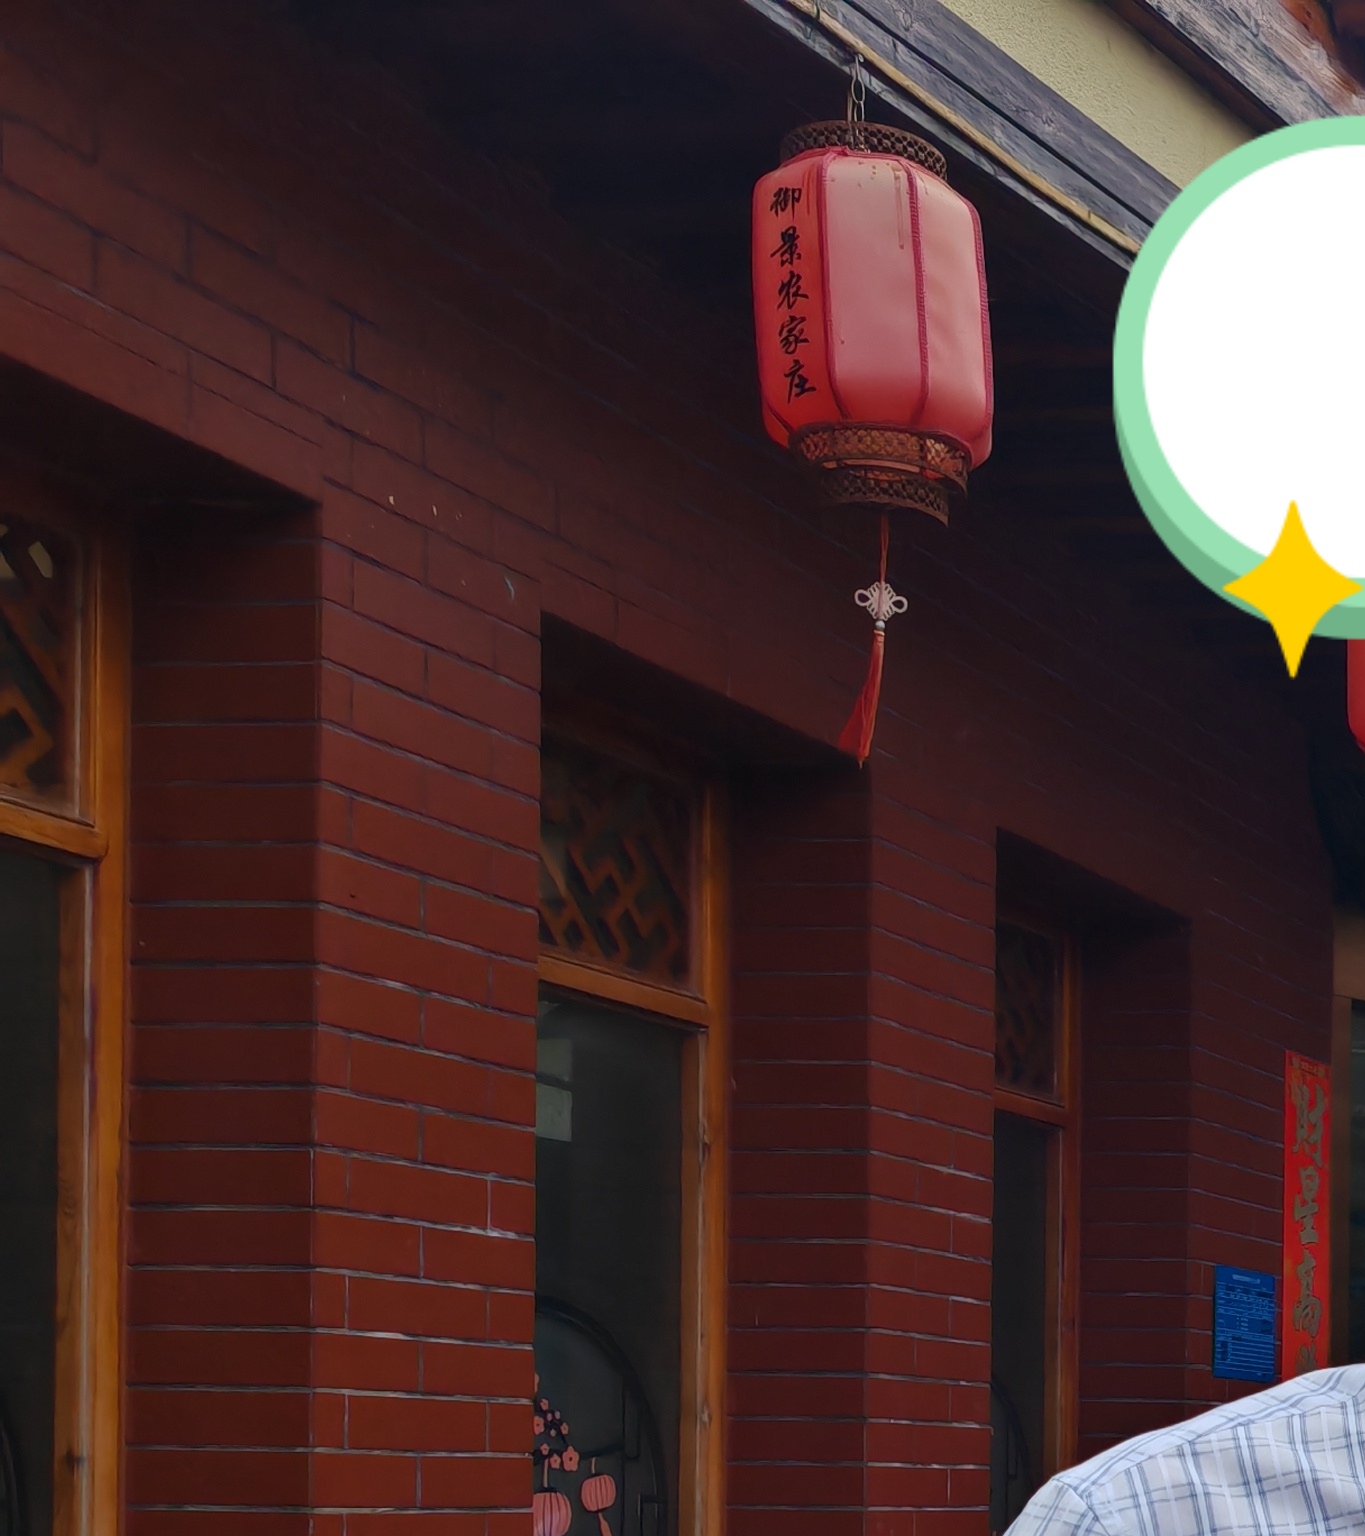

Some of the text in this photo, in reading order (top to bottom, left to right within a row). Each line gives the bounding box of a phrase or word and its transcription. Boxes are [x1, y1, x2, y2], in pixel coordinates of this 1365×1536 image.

[769, 186, 817, 404] 御景农家庄
